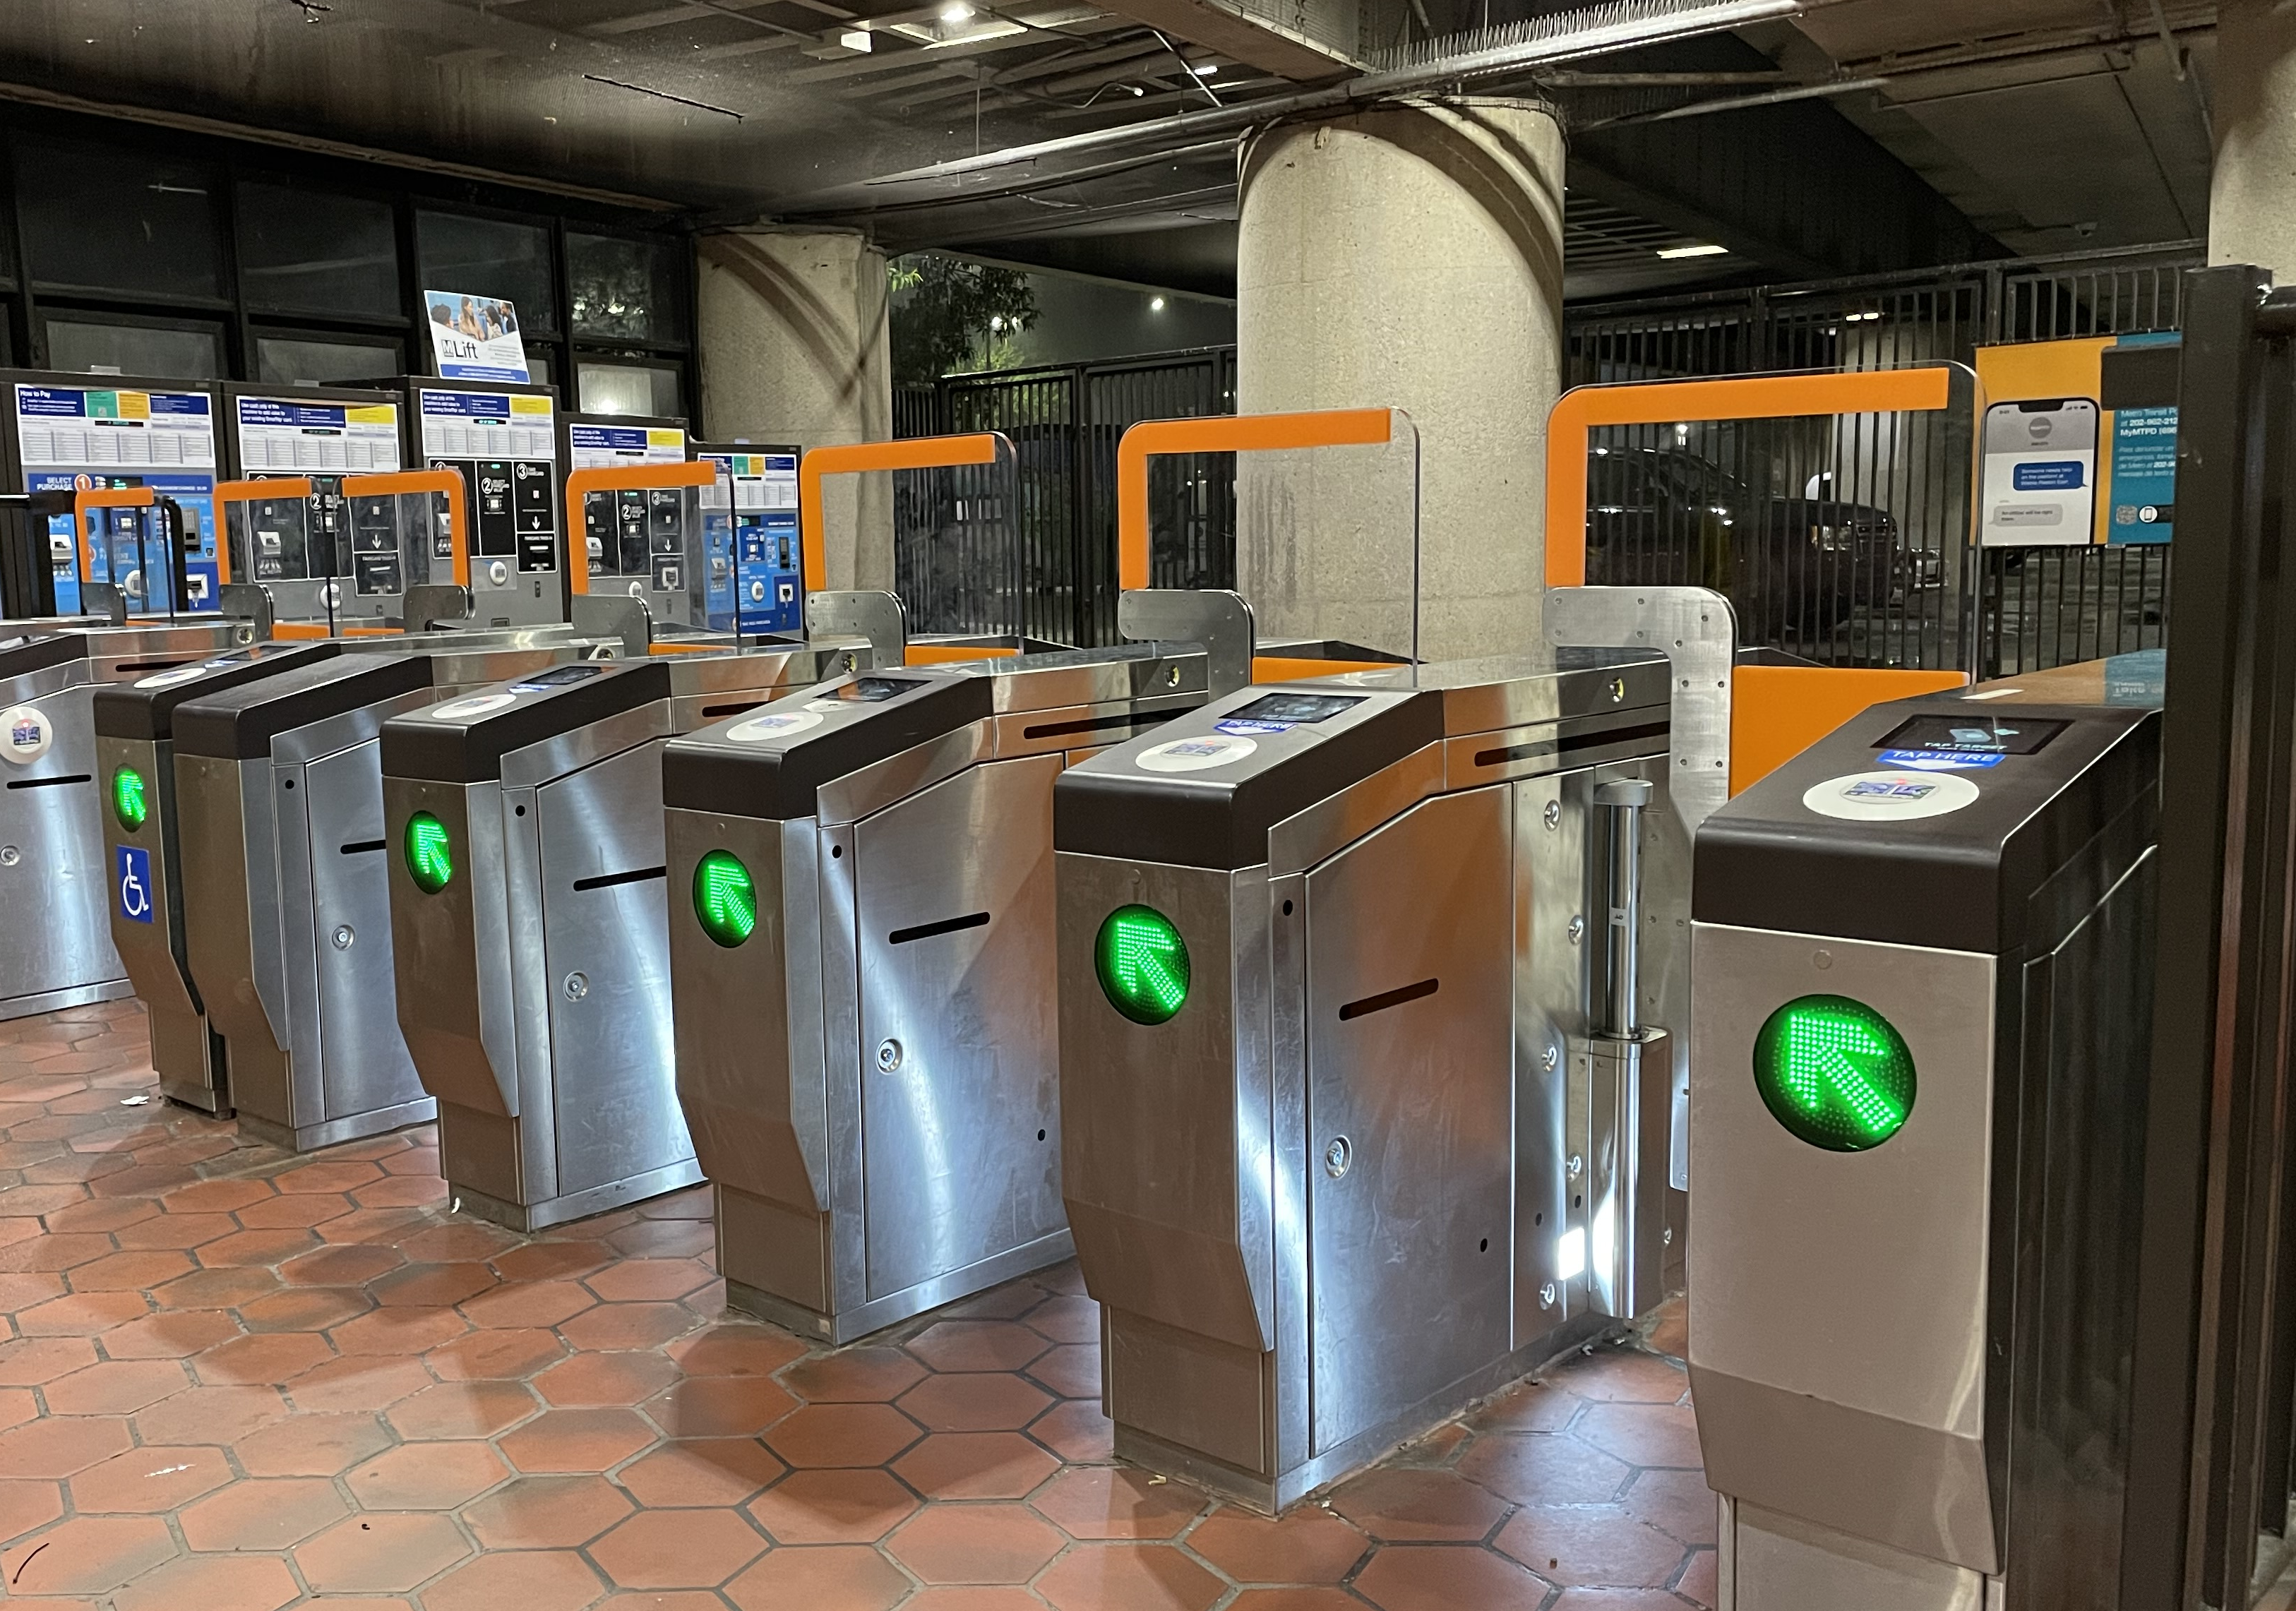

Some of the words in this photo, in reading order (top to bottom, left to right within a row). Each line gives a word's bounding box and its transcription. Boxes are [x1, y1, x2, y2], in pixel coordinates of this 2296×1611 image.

[453, 341, 478, 359] Lift
[40, 390, 51, 399] Pay
[2120, 427, 2157, 436] MyMTPD
[1935, 752, 1998, 762] HERE
